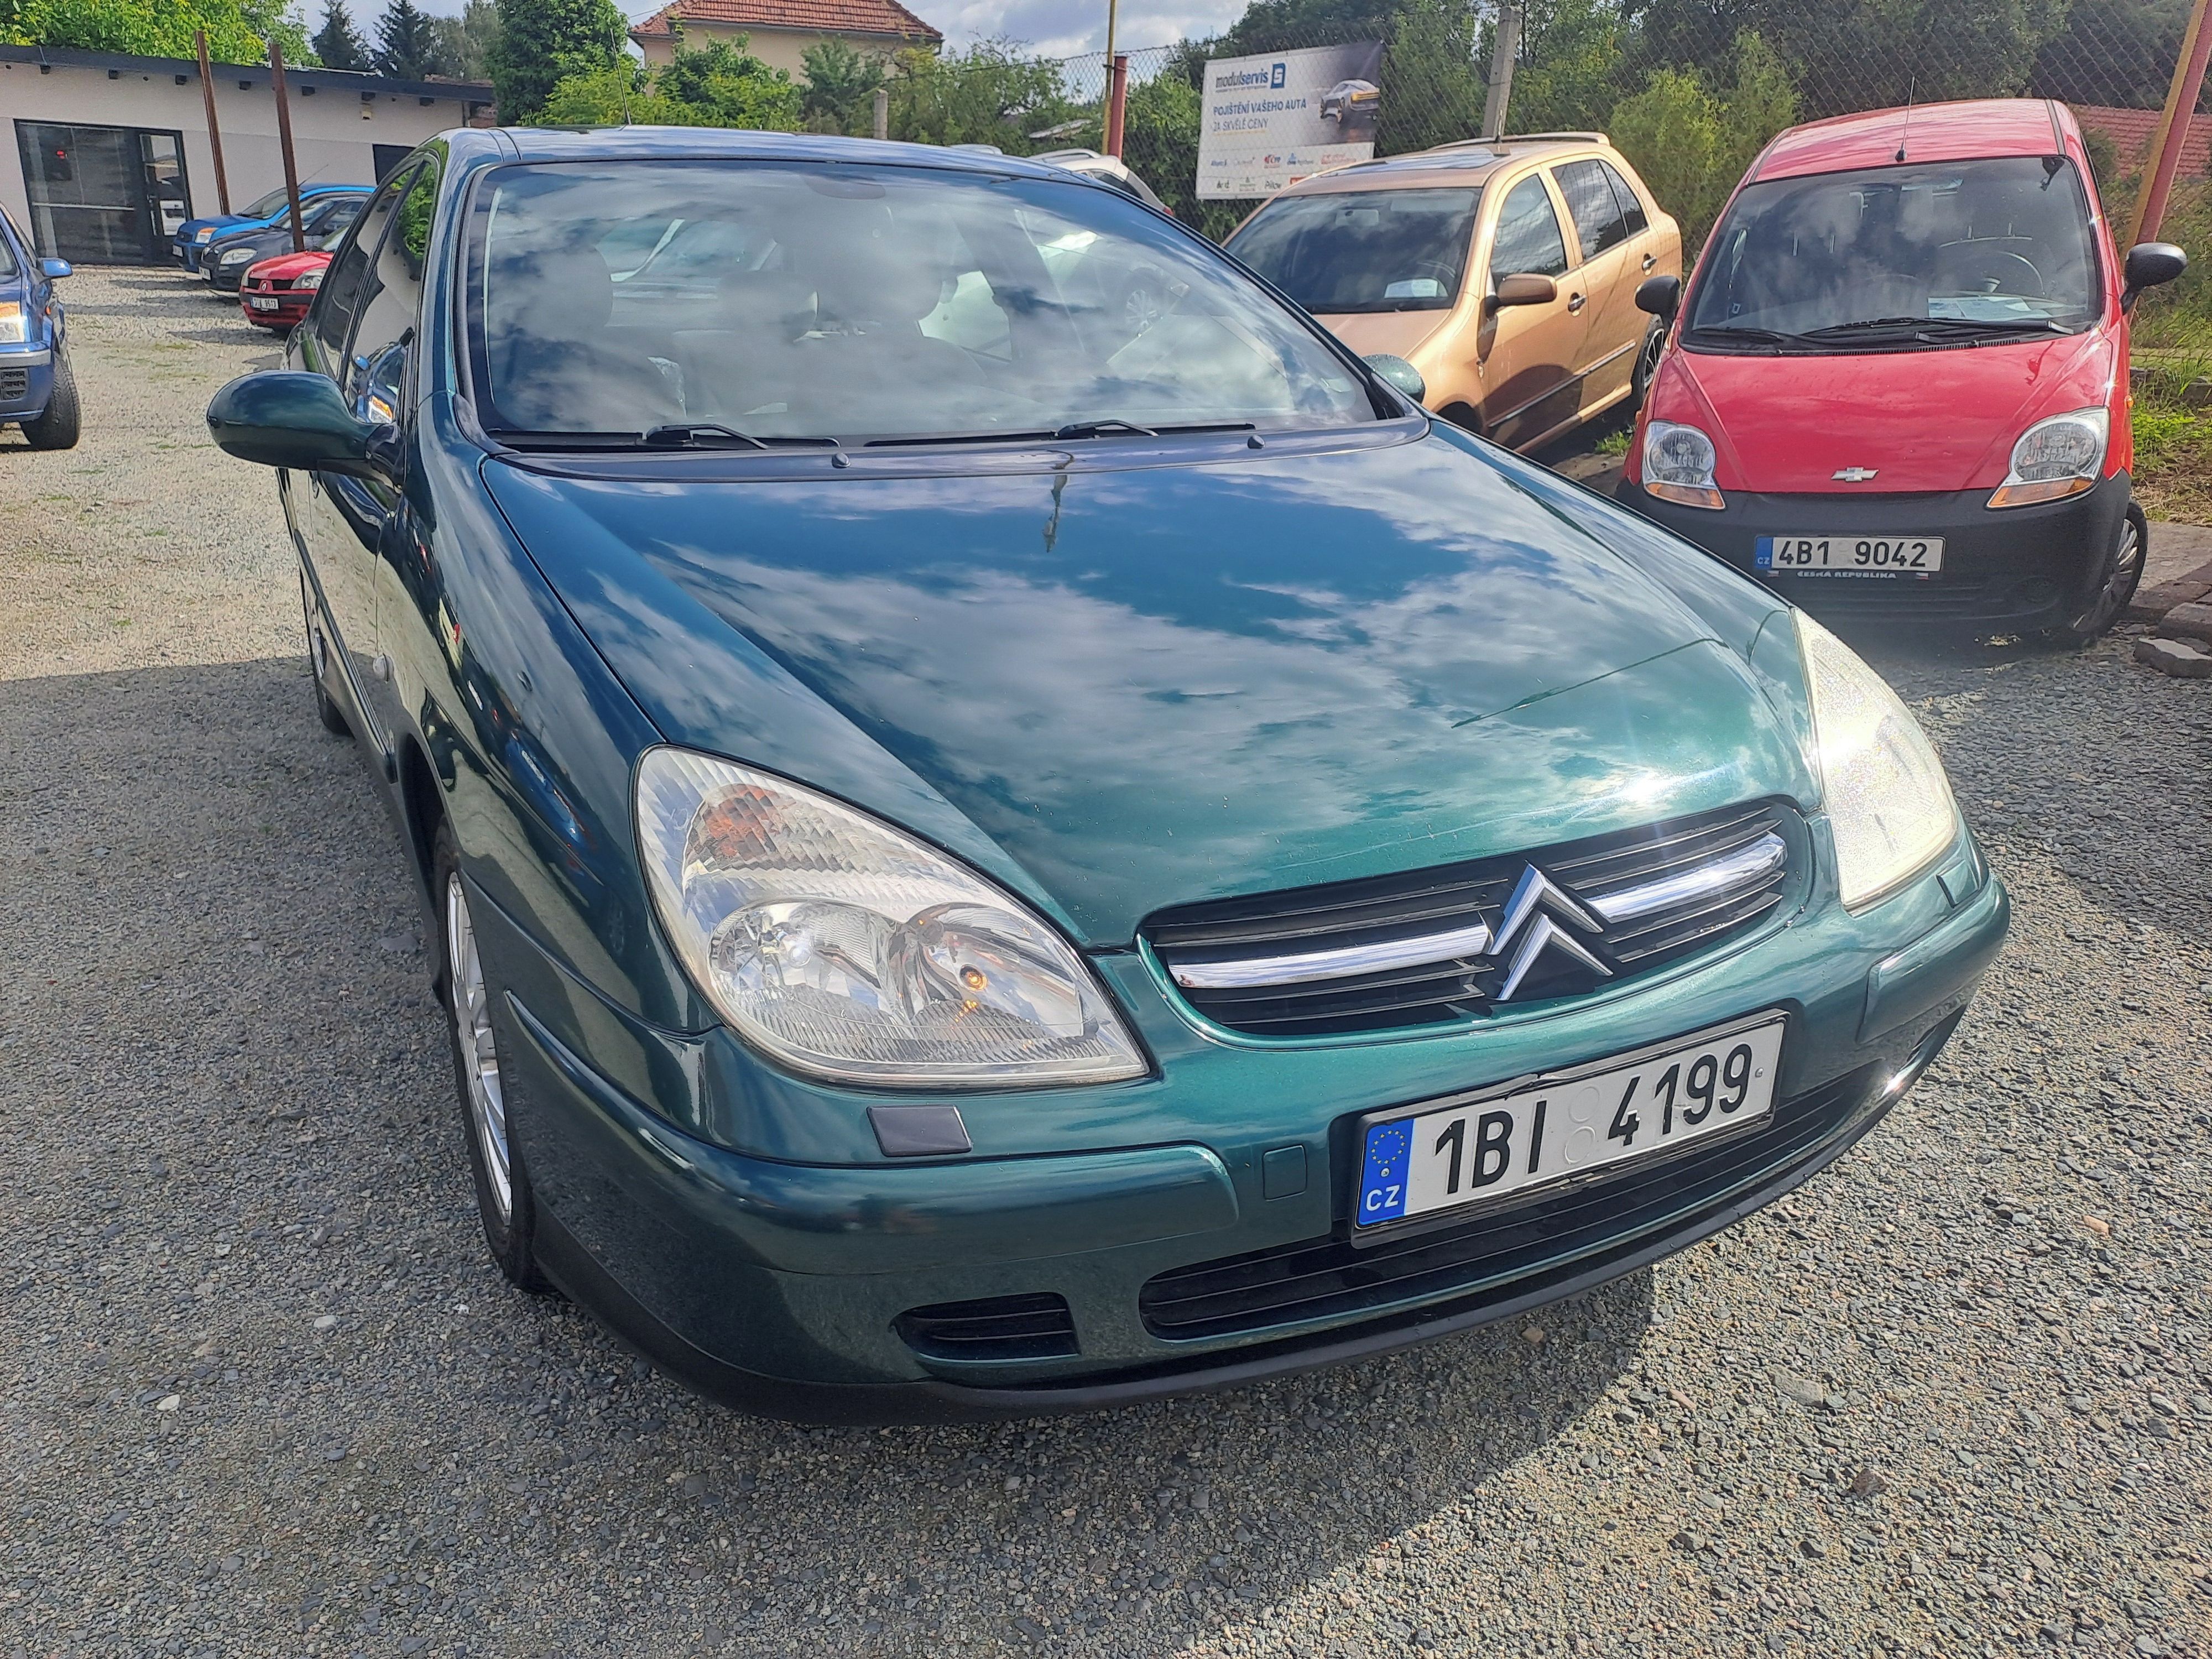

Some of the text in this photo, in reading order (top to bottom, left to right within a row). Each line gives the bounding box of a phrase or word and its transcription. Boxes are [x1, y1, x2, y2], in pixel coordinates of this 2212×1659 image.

[1215, 69, 1268, 88] modulservis
[1213, 97, 1307, 116] POJIŠTĚNÍ VAŠEHO AUTA
[1248, 118, 1269, 129] CENY
[1756, 557, 1770, 565] CZ
[1778, 540, 1928, 567] 4B1 9042
[1433, 1043, 1753, 1195] 1BI 4199
[1365, 1183, 1400, 1212] CZ
